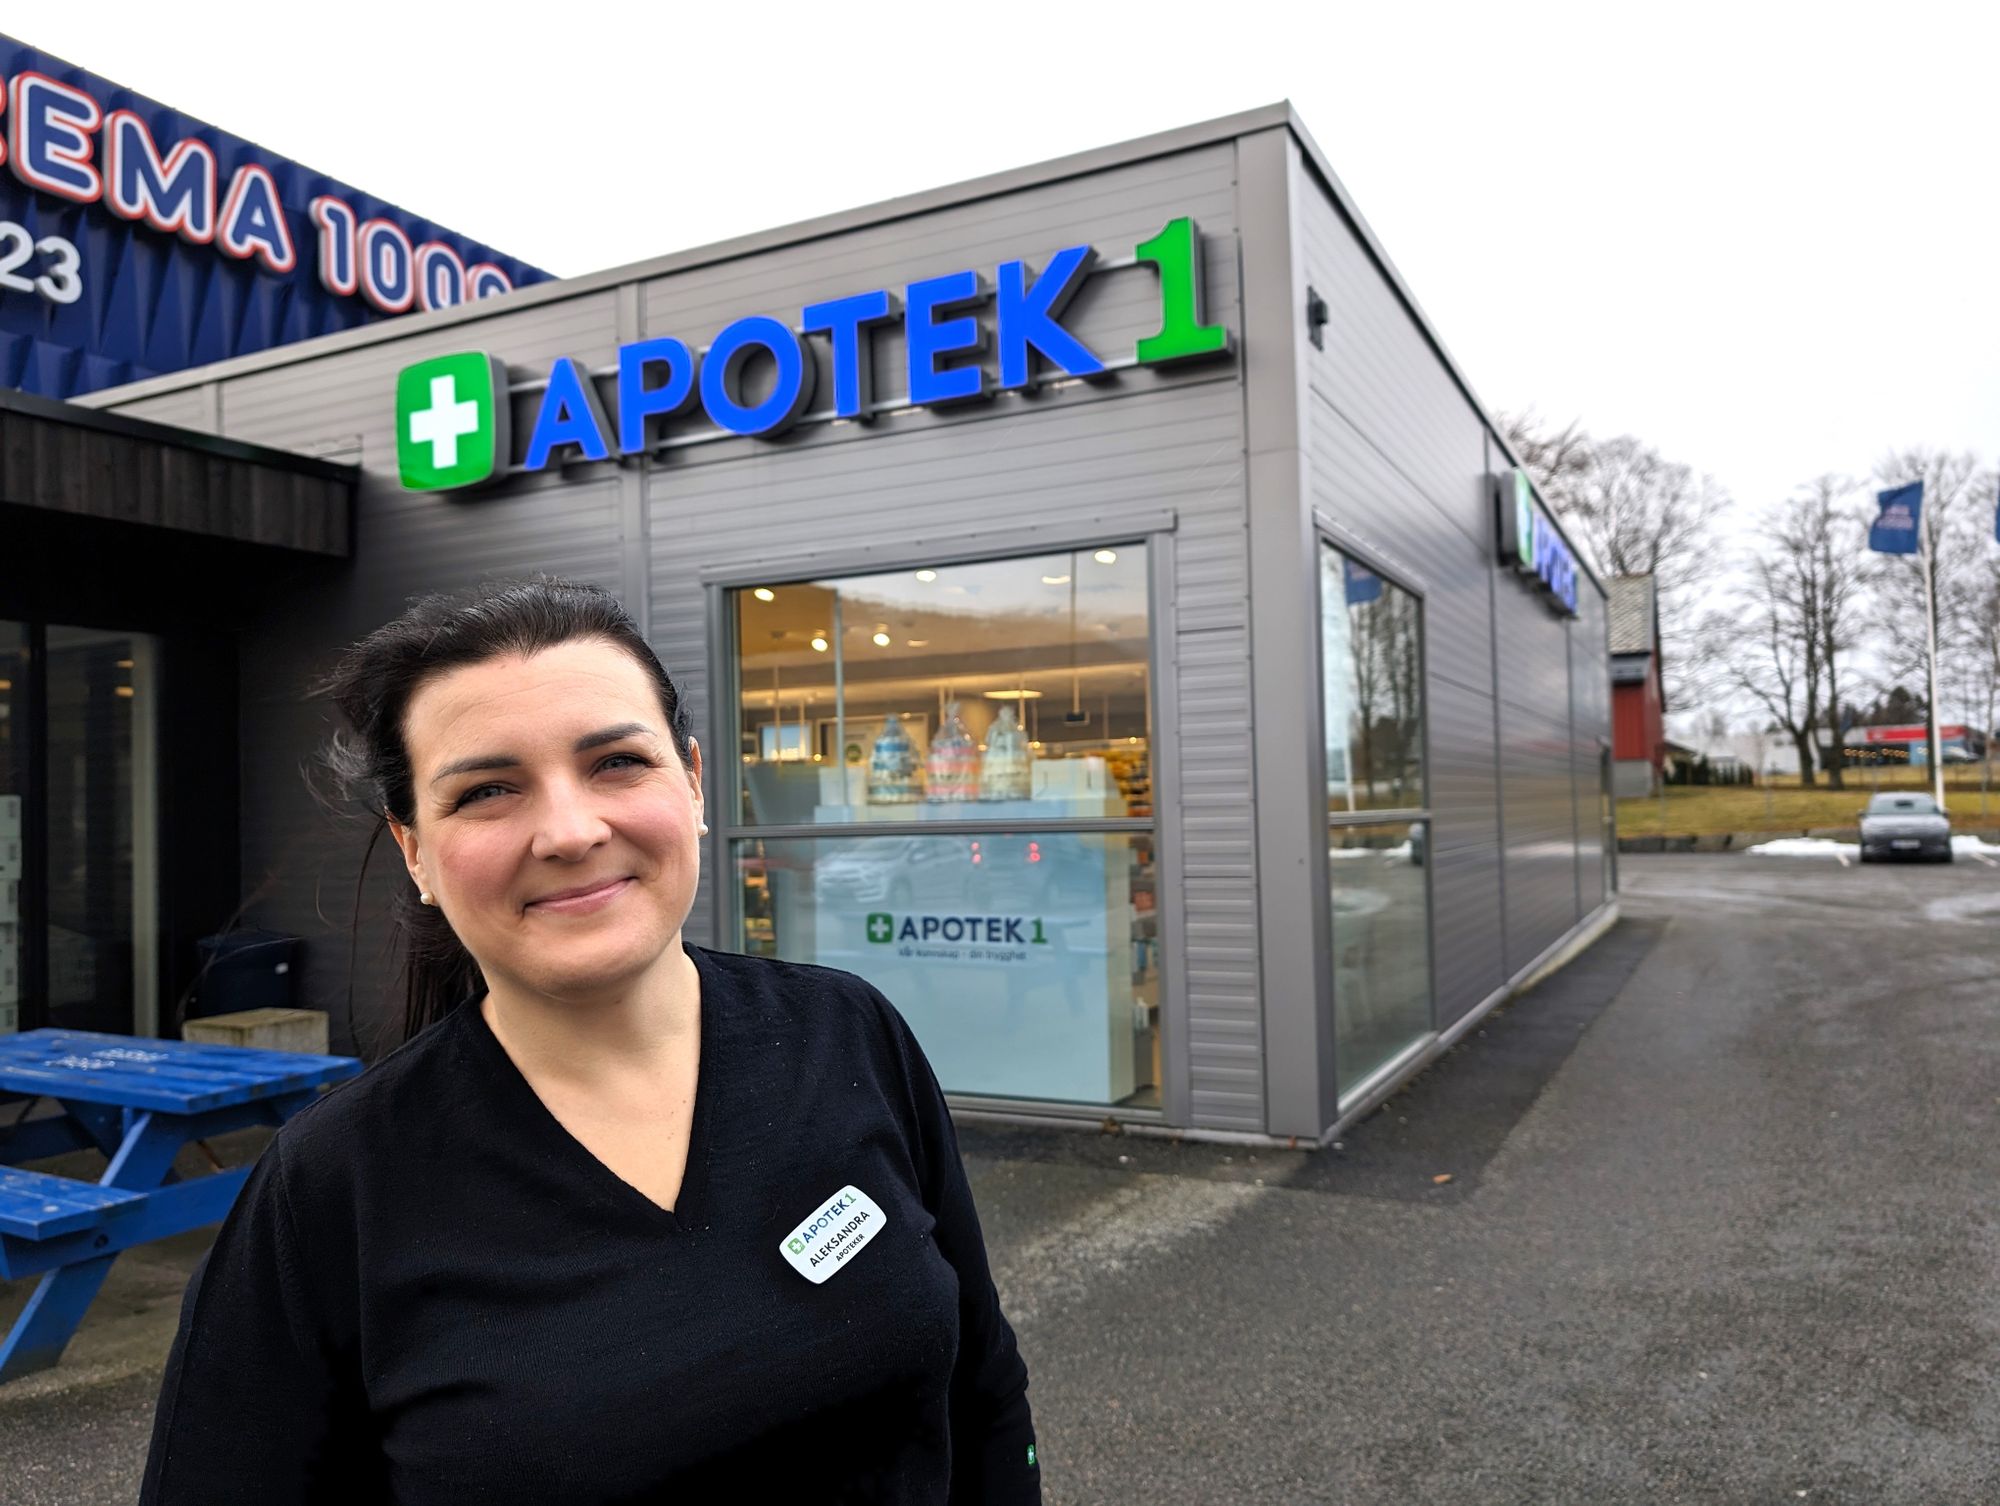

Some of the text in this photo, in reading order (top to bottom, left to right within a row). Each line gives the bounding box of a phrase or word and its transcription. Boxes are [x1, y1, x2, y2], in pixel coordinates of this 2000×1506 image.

[0, 71, 296, 273] EMA
[523, 216, 1229, 471] APOTEK 1
[898, 916, 1048, 944] APOTEK 1
[802, 1193, 857, 1243] APOTEK 1
[809, 1211, 871, 1268] ALEKSANDRA
[835, 1233, 865, 1262] APOTEKER
